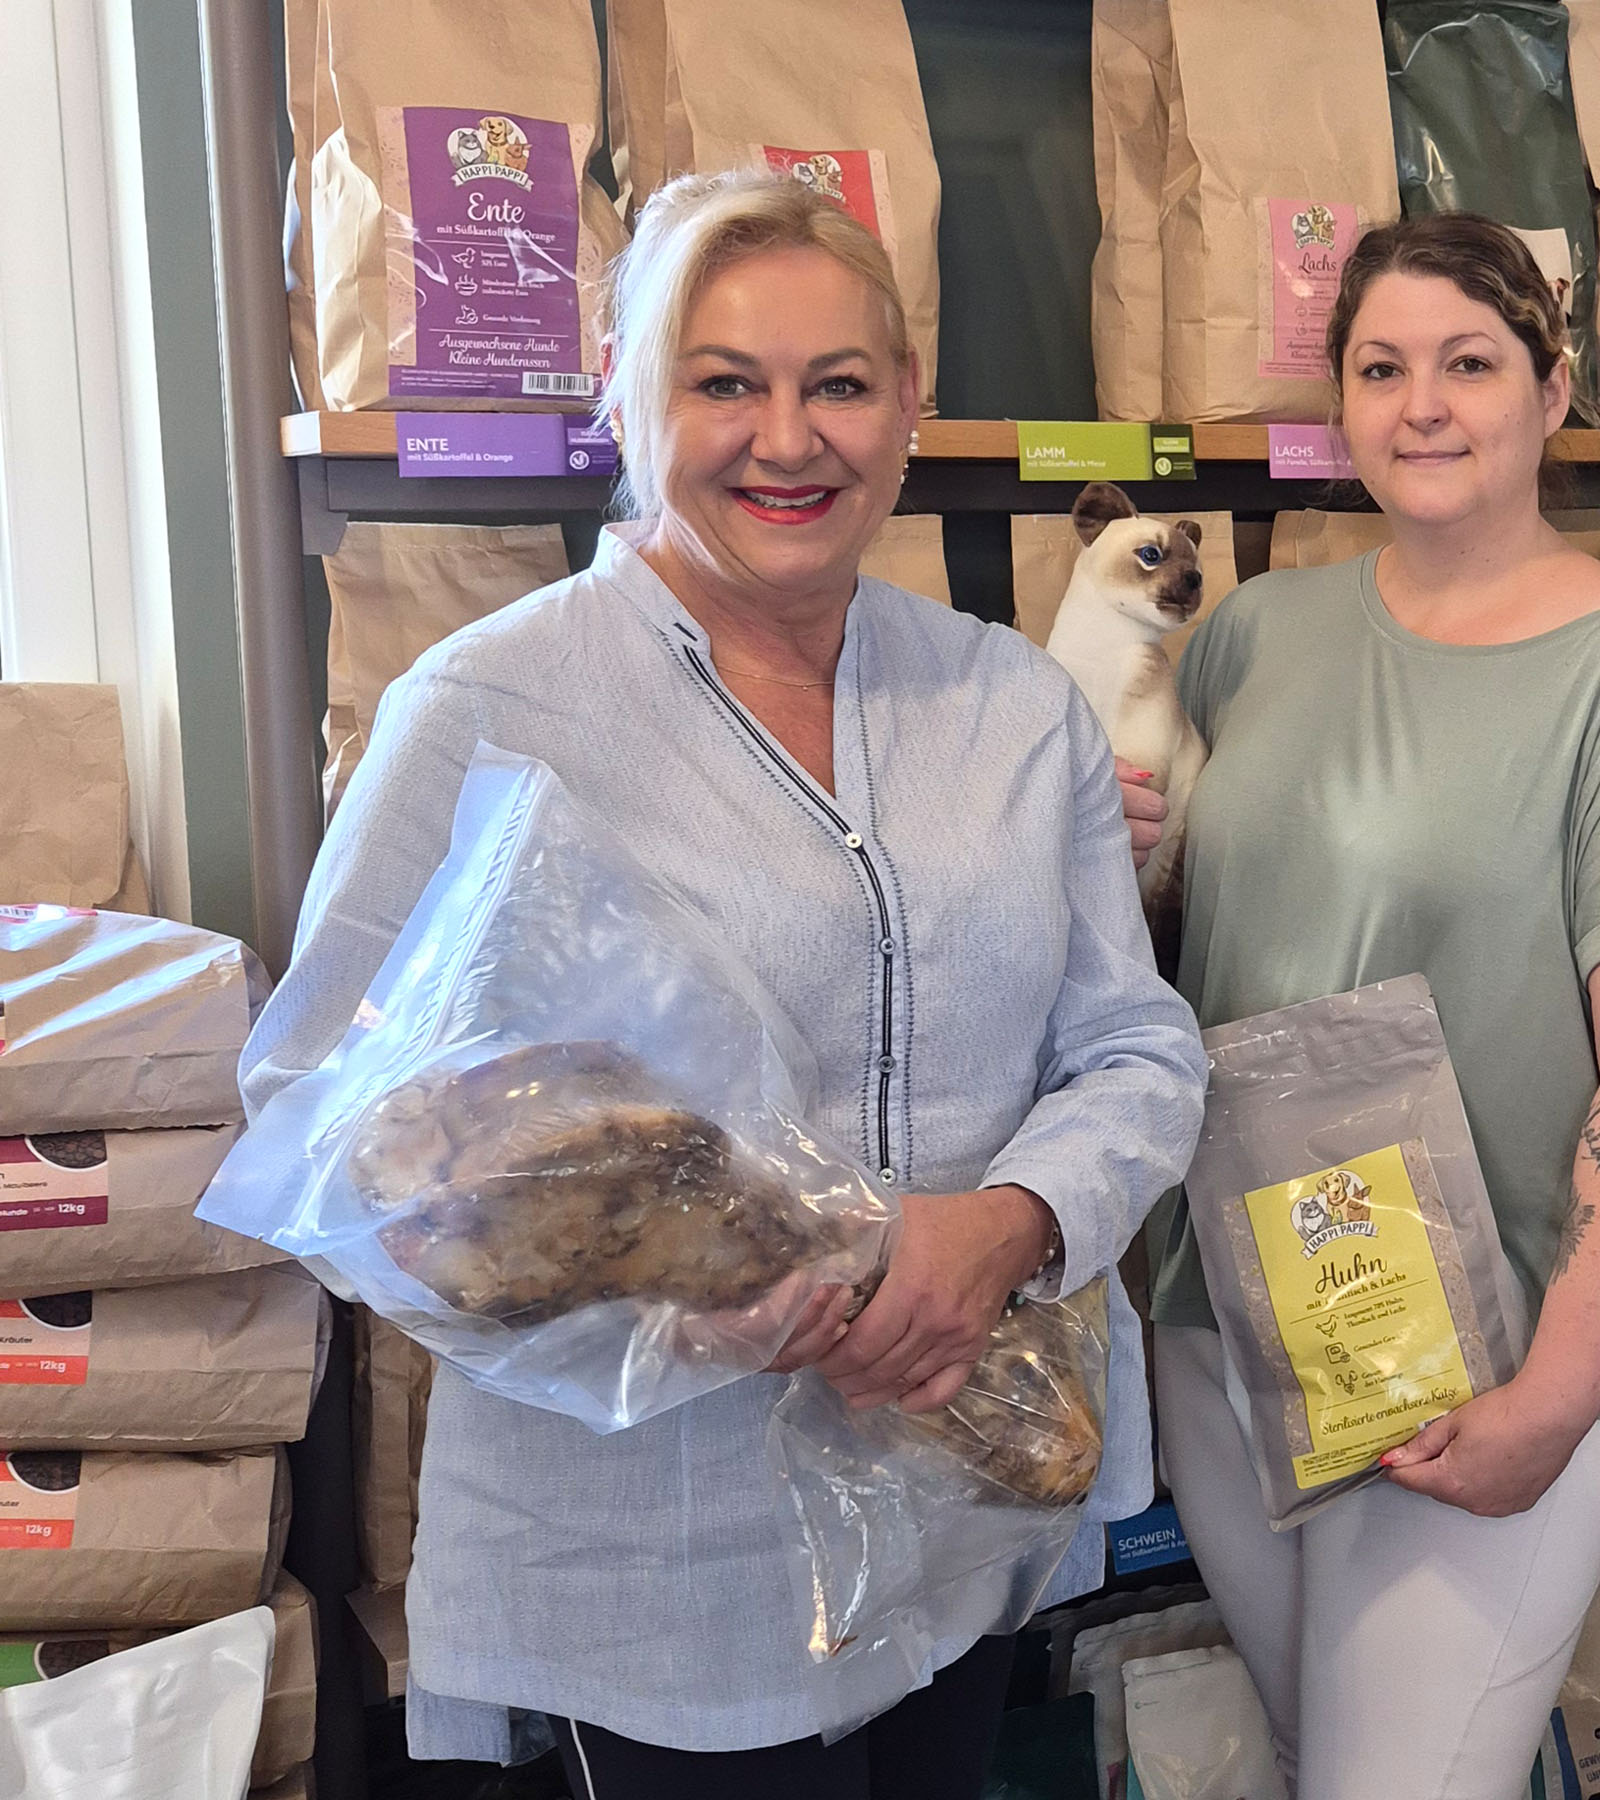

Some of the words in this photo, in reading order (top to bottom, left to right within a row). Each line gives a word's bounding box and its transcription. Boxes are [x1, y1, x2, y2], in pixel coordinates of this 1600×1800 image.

[462, 165, 495, 182] HAPPI
[494, 165, 525, 184] PAPPI
[467, 192, 526, 224] Ente
[1298, 252, 1337, 275] Lachs
[439, 334, 522, 353] Ausgewachsene
[523, 339, 560, 353] Hunde
[449, 350, 482, 366] Kleine
[406, 437, 449, 451] ENTE
[1275, 446, 1314, 457] LACHS
[407, 453, 422, 462] mit
[476, 453, 482, 462] &
[483, 453, 513, 464] Orange
[1026, 447, 1066, 459] LAMM
[58, 1204, 86, 1215] 12kg
[1310, 1227, 1340, 1250] HAPPI
[1339, 1222, 1370, 1237] PAPPI
[1315, 1253, 1388, 1295] Huhn
[1380, 1273, 1407, 1287] Lachs
[40, 1360, 67, 1374] 12kg
[25, 1524, 53, 1537] 12kg
[1118, 1528, 1177, 1552] SCHWEIN
